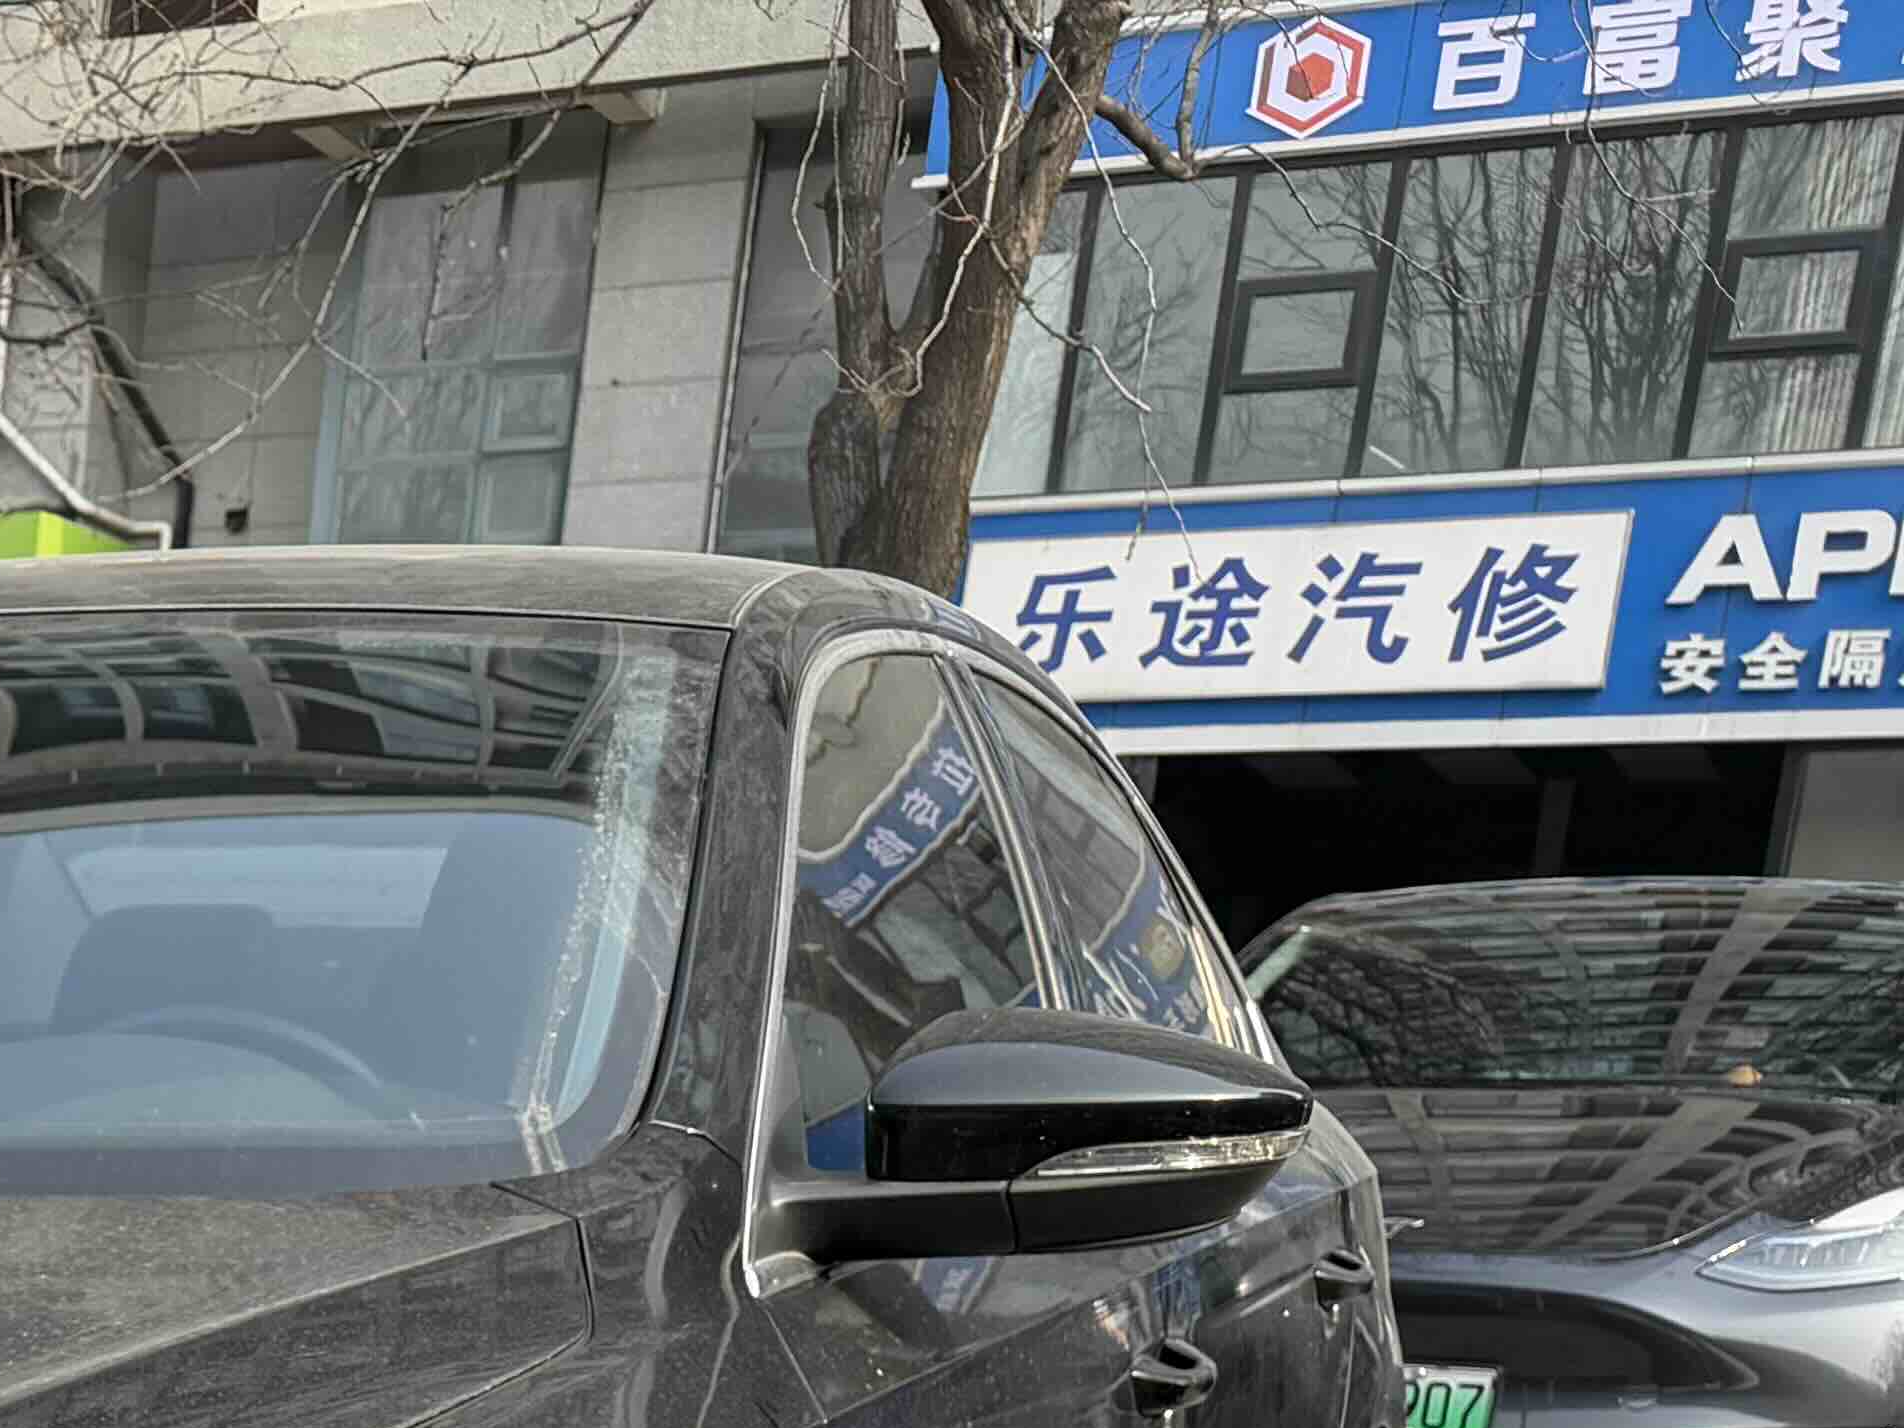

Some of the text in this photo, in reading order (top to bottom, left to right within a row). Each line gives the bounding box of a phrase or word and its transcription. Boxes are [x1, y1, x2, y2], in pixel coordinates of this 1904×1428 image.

[1433, 0, 1848, 112] 百富聚
[1017, 544, 1580, 673] 乐途汽修
[1665, 510, 1904, 605] AP
[1659, 629, 1904, 695] 安全隔
